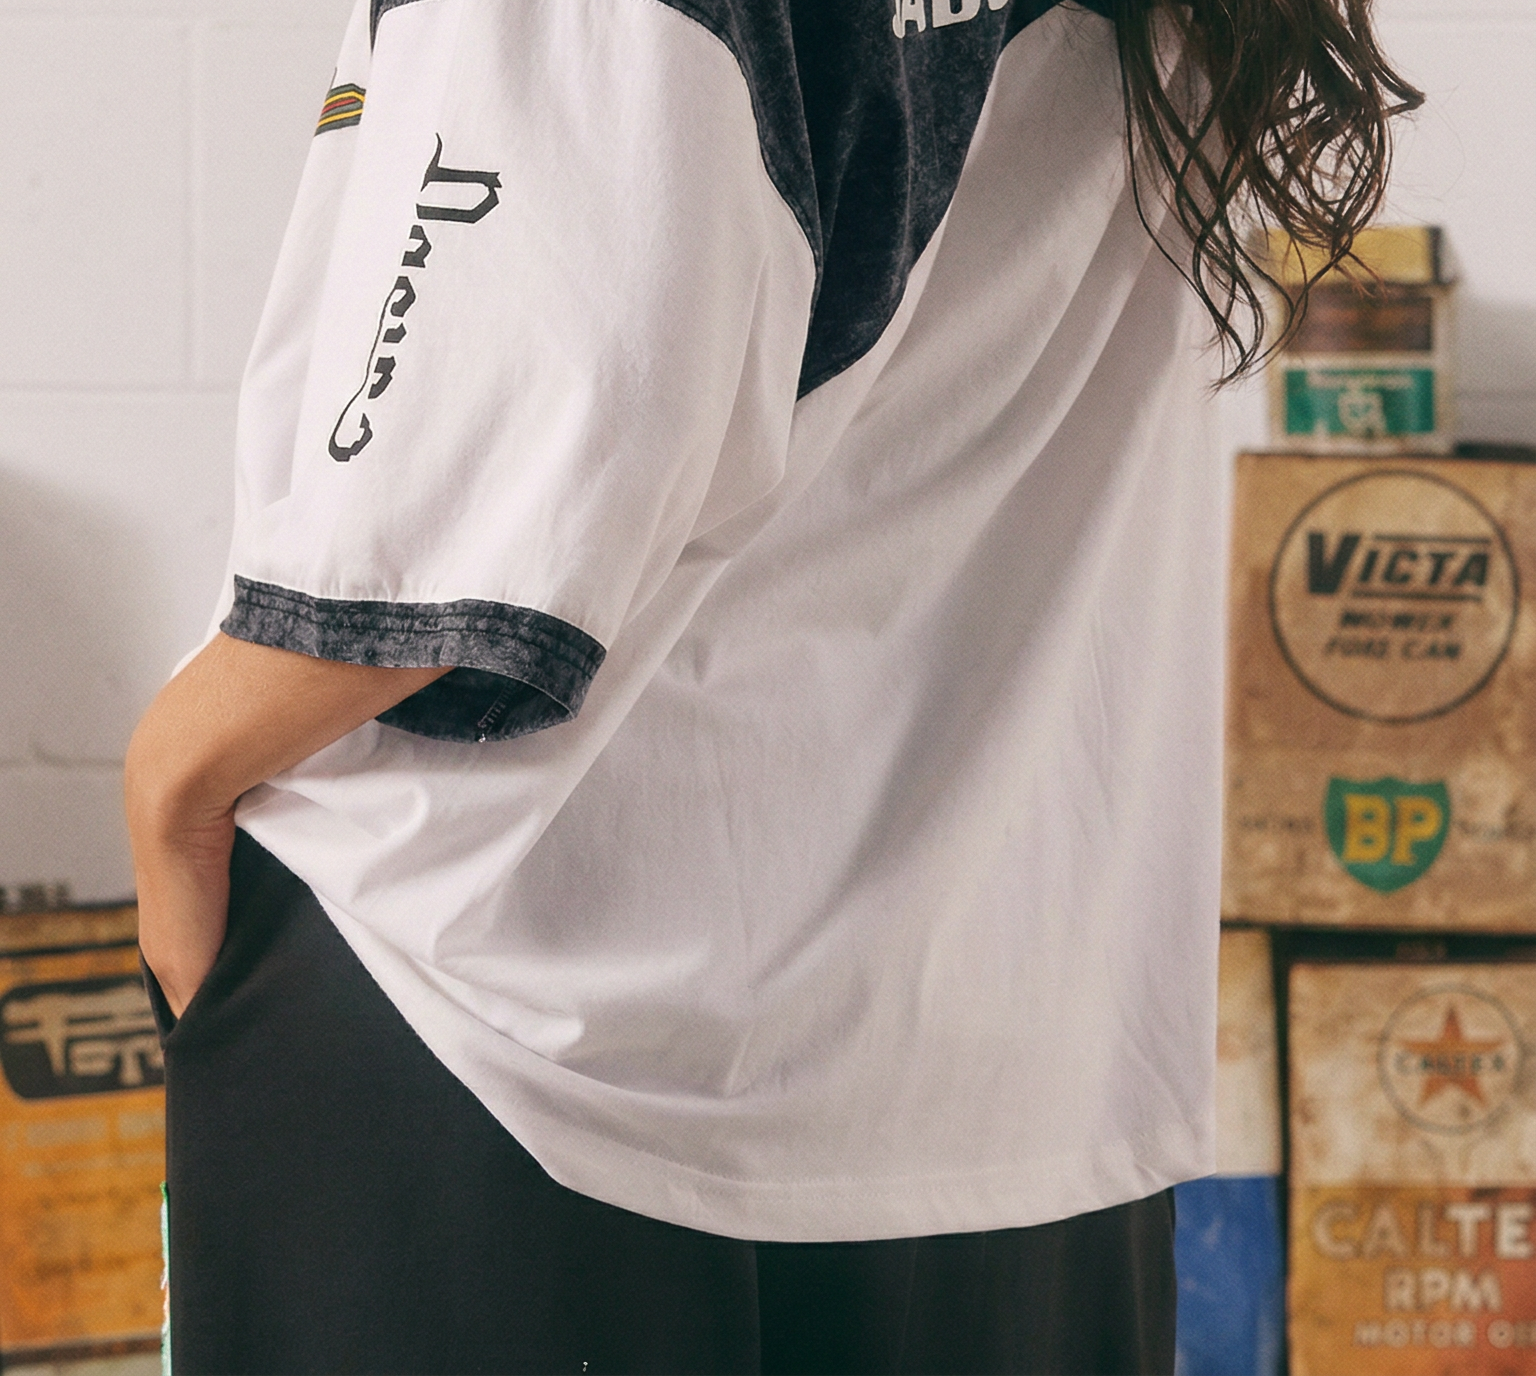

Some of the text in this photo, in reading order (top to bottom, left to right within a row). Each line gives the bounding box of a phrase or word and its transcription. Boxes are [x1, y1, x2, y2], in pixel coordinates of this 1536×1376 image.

[1307, 533, 1490, 595] VICTA
[1342, 794, 1442, 866] BP
[1384, 1266, 1502, 1313] RPM
